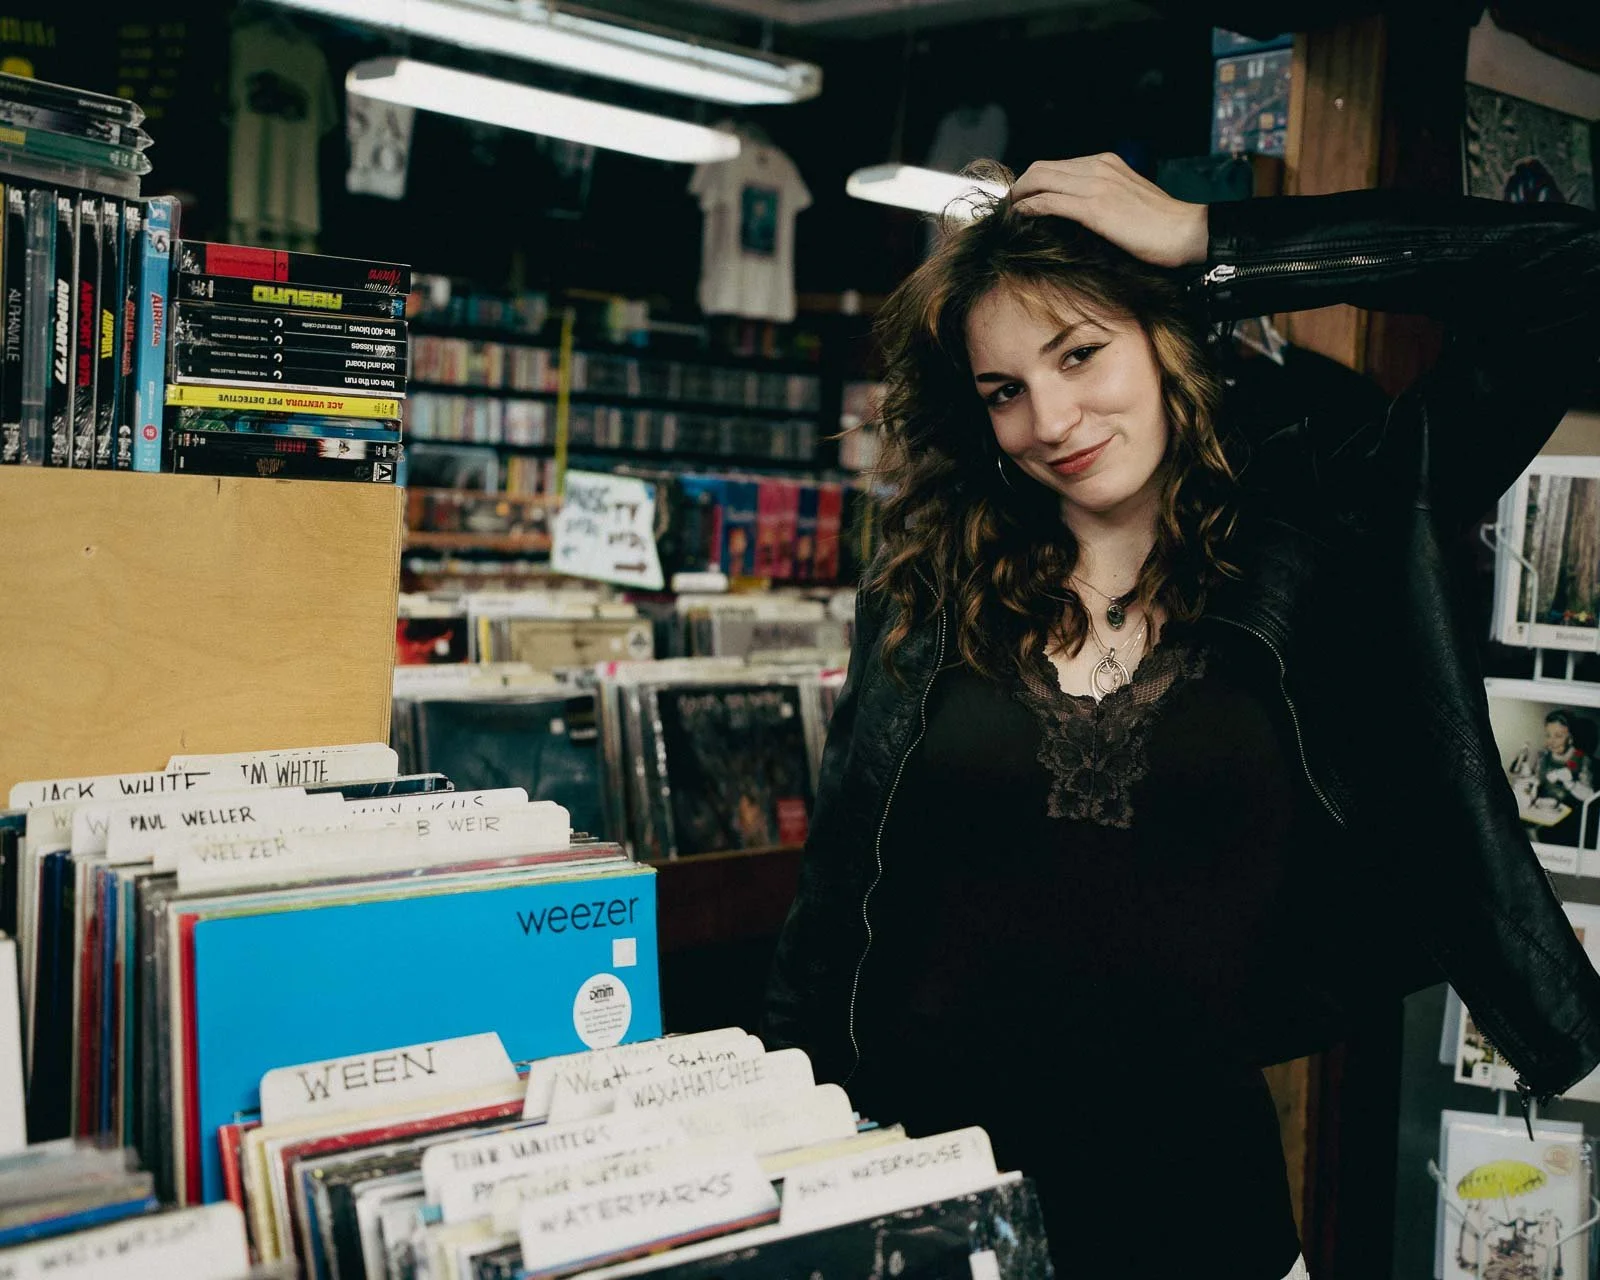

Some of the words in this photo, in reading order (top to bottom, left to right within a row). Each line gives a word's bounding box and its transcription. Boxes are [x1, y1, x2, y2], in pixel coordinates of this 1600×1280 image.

[252, 284, 344, 310] ABSURD
[57, 278, 70, 357] AIRPORT
[79, 279, 94, 349] AIRPORT
[6, 287, 22, 362] ALPHAVILLE
[349, 325, 370, 335] blows
[101, 308, 115, 359] AIRPORT
[370, 327, 384, 336] 400
[384, 327, 396, 337] the
[351, 342, 374, 352] kisses
[374, 344, 396, 353] stolen
[345, 359, 366, 369] board
[367, 361, 381, 370] and
[381, 362, 396, 371] bed
[344, 376, 357, 385] run
[358, 378, 370, 386] the
[381, 379, 395, 388] love
[218, 394, 265, 405] DETECTIVE
[267, 397, 283, 405] PET
[286, 398, 325, 409] VENTURA
[327, 401, 344, 410] ACE
[276, 759, 329, 786] WHITE
[130, 814, 167, 832] PAUL
[181, 805, 256, 827] WELLER
[448, 815, 501, 833] WEIR
[516, 896, 639, 936] weezer
[297, 1046, 438, 1102] WEEN
[631, 1058, 768, 1109] WAXAHATCHEE
[539, 1172, 733, 1233] WATERPARKS
